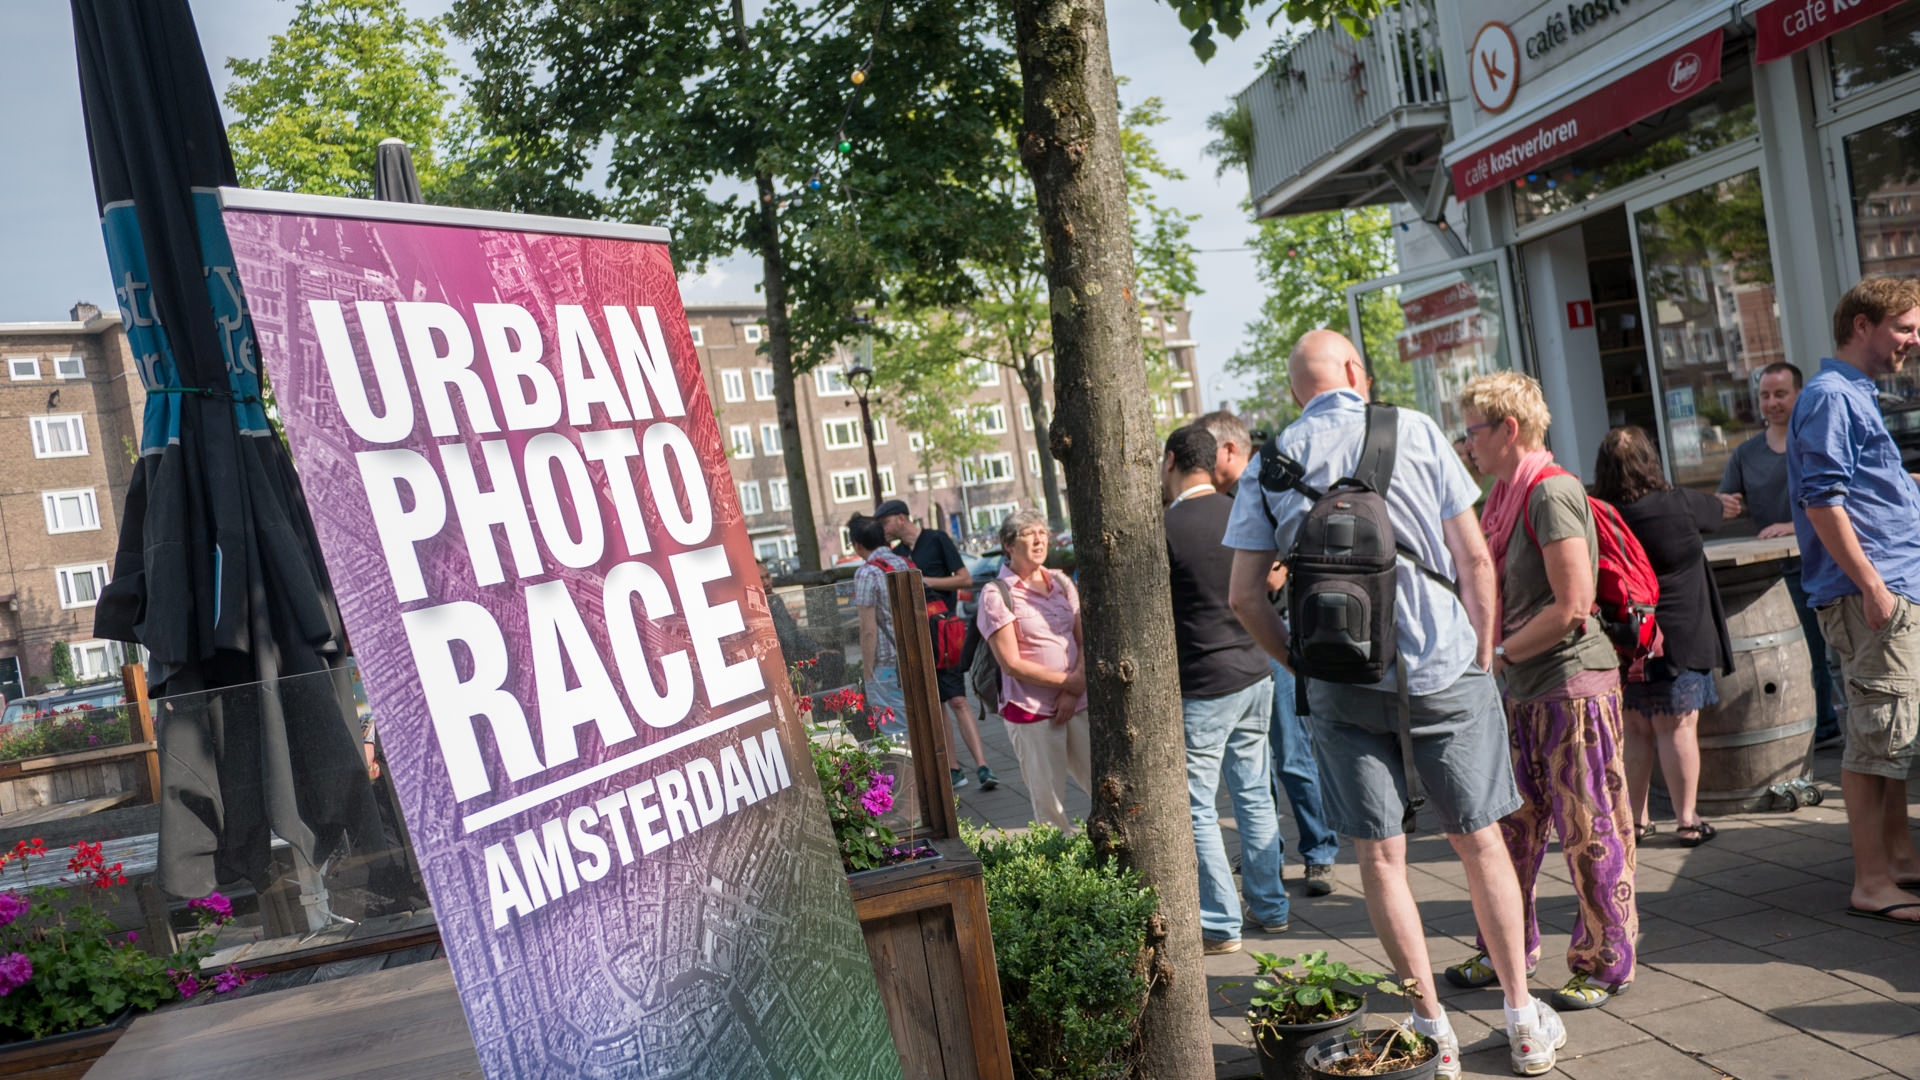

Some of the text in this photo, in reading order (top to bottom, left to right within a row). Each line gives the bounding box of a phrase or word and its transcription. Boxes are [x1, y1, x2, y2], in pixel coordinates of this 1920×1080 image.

[1465, 118, 1578, 187] café kostverloren
[308, 300, 686, 443] URBAN
[355, 422, 713, 603] PHOTO
[401, 544, 766, 803] RACE
[483, 727, 791, 930] AMSTERDAM
